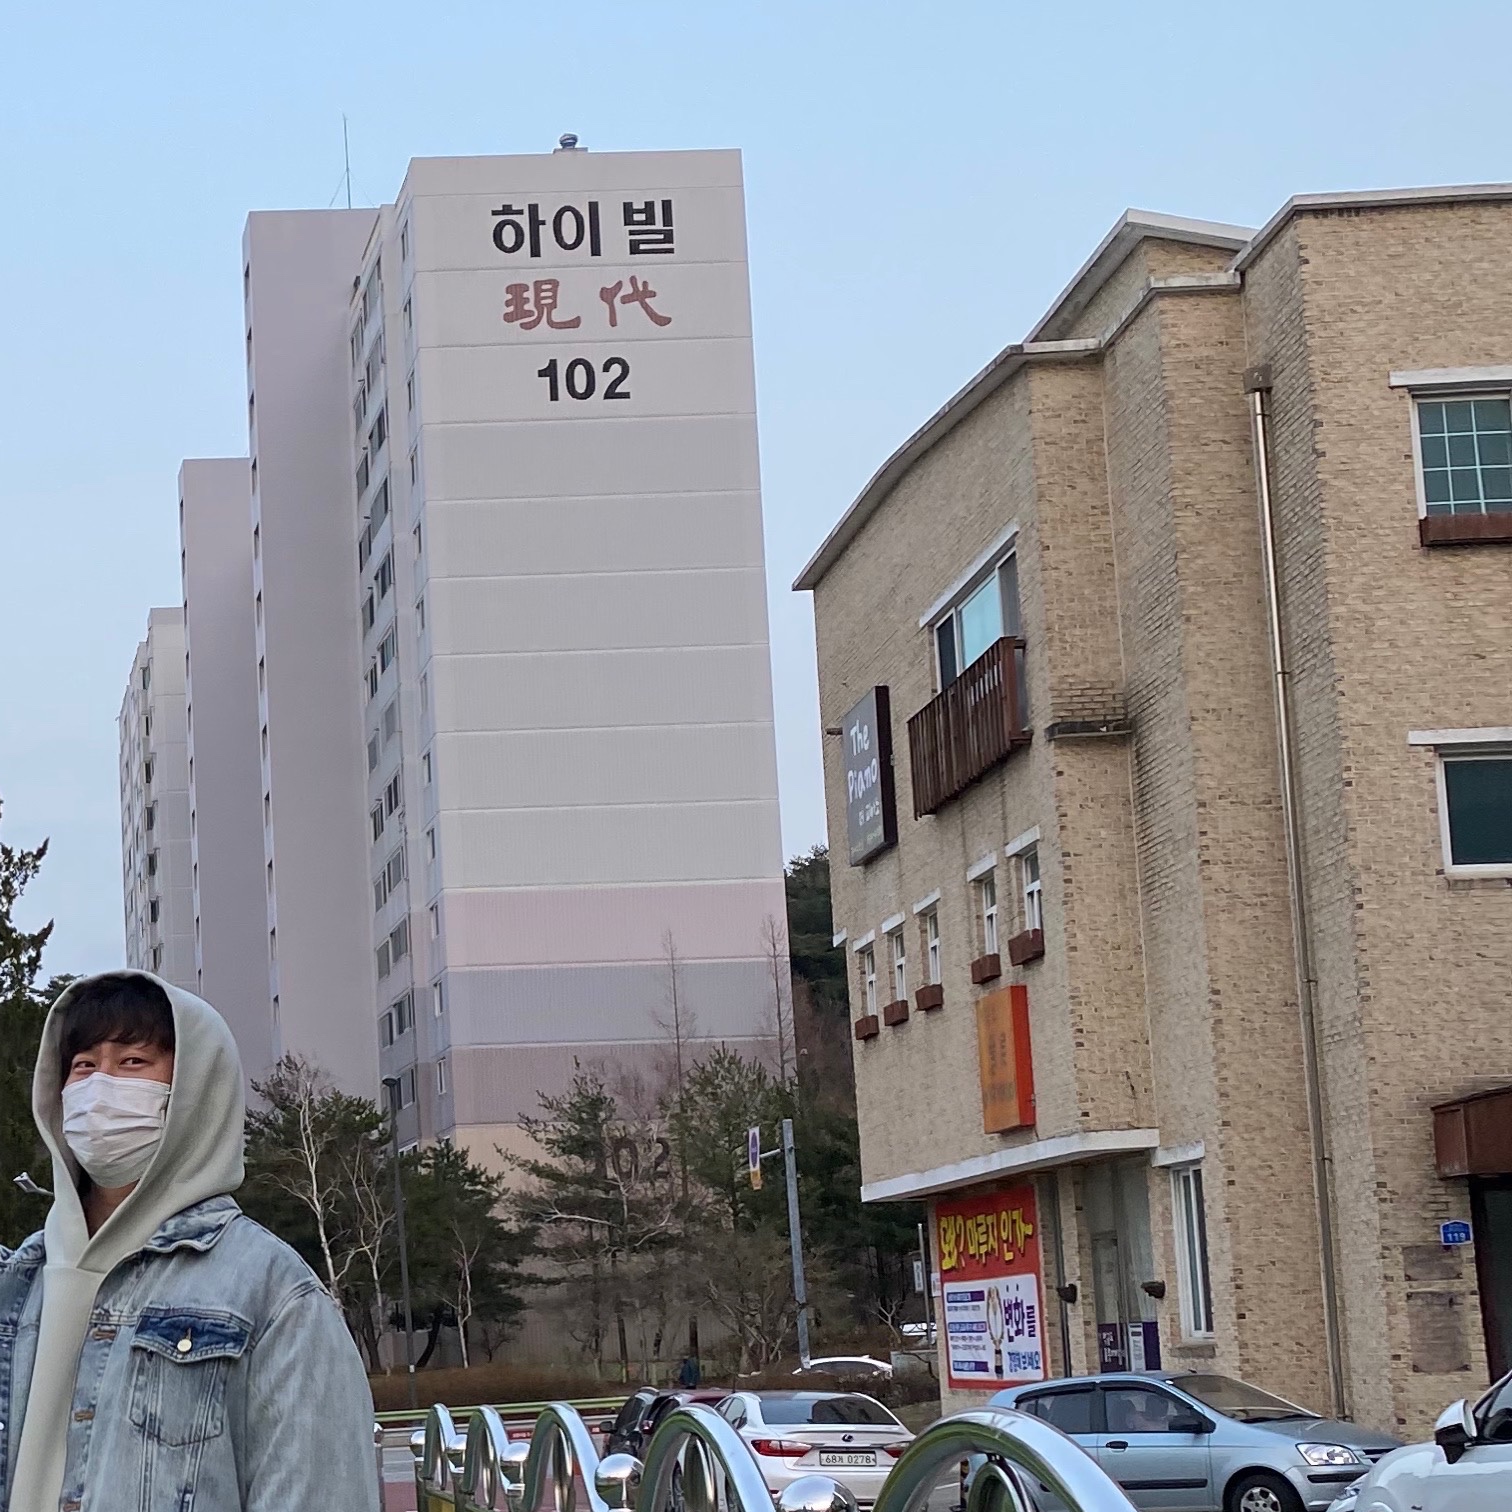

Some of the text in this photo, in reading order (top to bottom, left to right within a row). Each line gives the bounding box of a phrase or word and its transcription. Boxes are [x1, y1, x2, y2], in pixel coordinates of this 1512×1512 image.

[491, 199, 675, 258] 하이빌
[502, 275, 672, 331] 現代
[538, 356, 631, 402] 102
[849, 719, 870, 756] The
[847, 758, 878, 804] Piano
[847, 1454, 872, 1464] 0278
